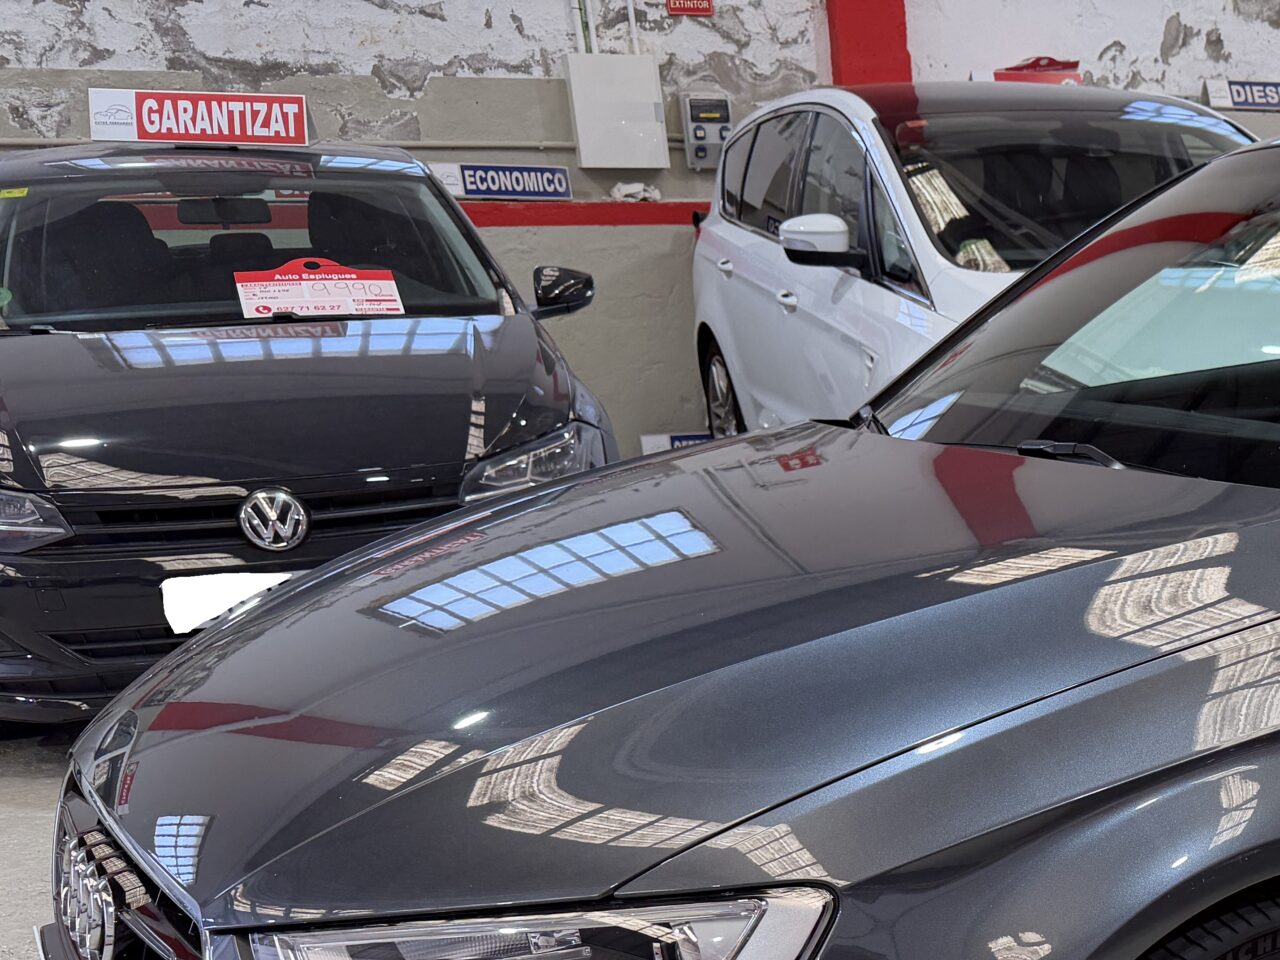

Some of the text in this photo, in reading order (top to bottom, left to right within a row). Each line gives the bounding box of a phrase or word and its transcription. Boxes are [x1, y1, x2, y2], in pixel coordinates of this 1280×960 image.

[670, 0, 710, 9] EXTINTOR
[141, 98, 299, 137] GARANTIZAT
[463, 169, 567, 193] ECONOMICO
